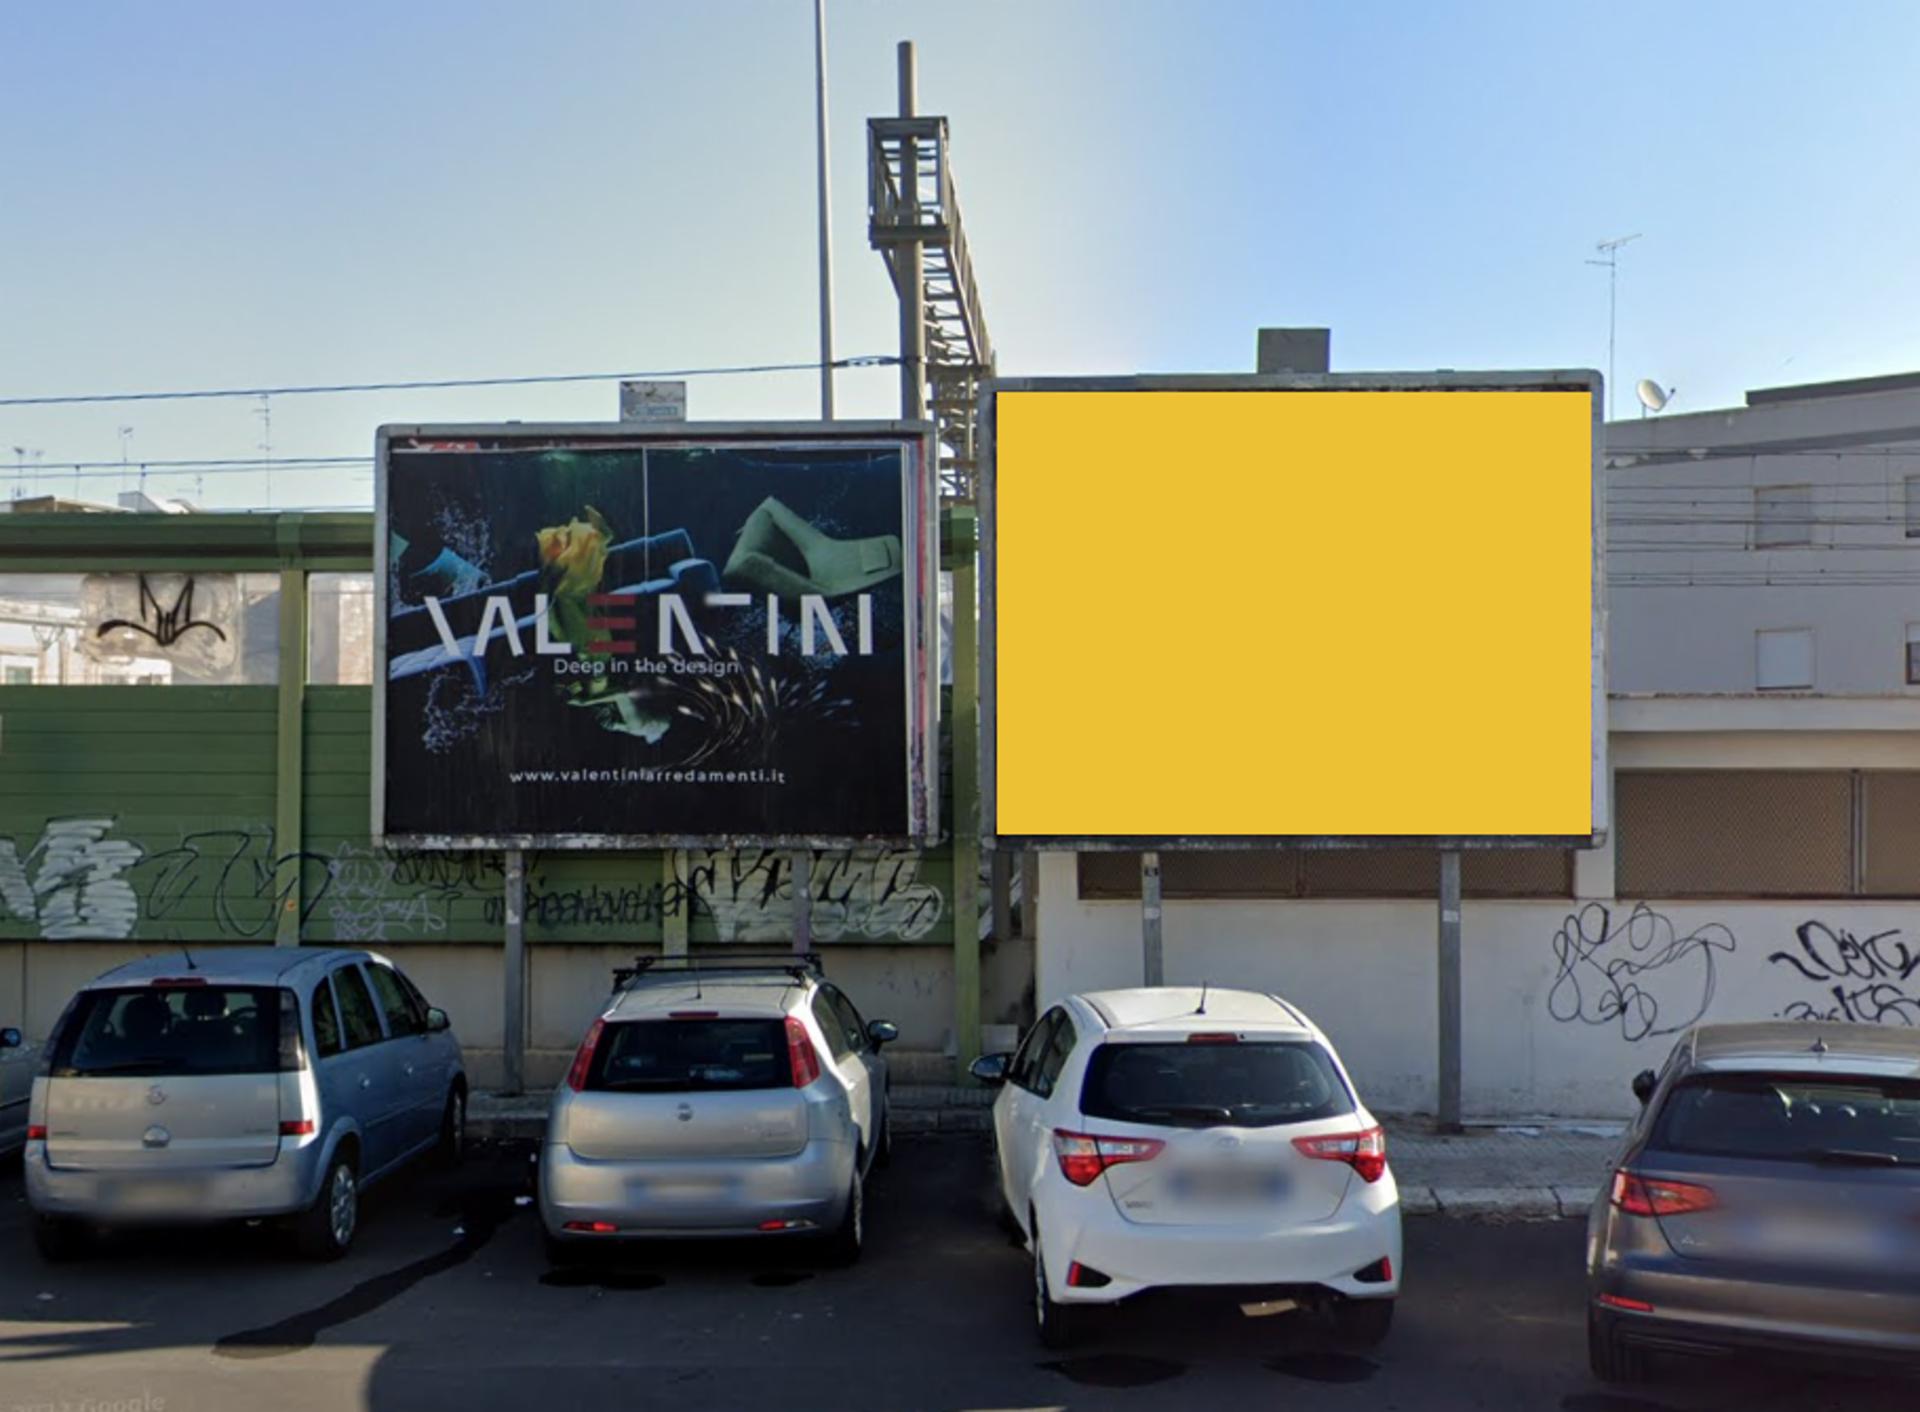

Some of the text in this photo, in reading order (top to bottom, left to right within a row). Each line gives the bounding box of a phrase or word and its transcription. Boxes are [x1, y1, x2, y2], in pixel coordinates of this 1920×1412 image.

[554, 657, 740, 678] Deep in the design
[509, 767, 786, 784] www.valentiniarredamenti.it
